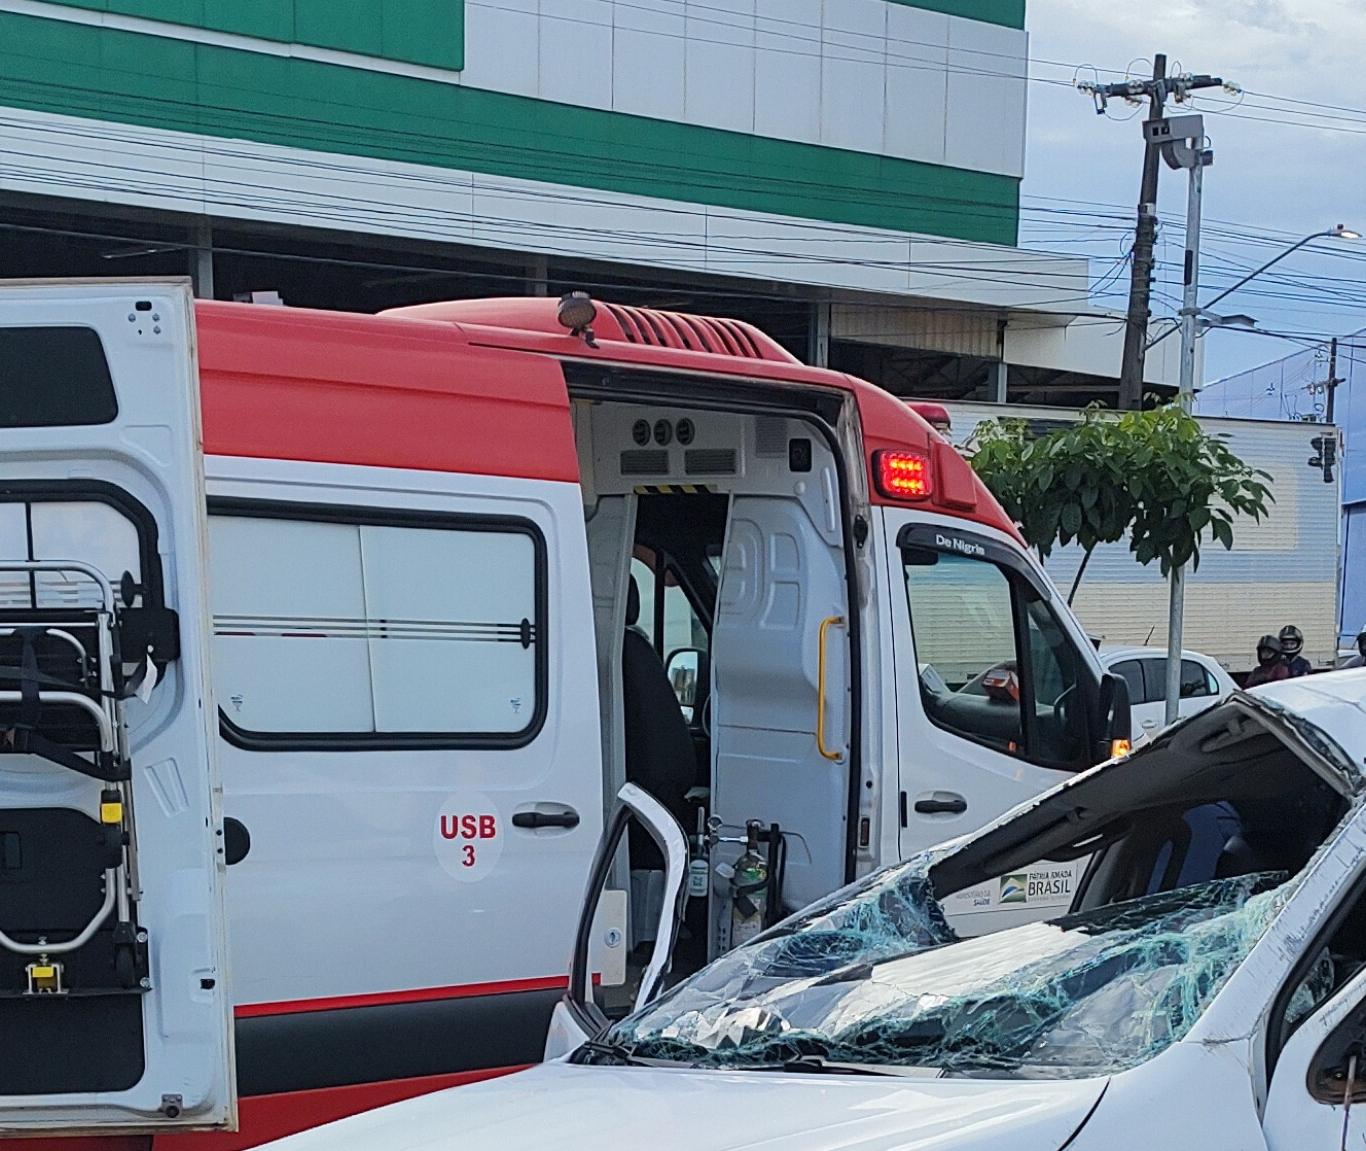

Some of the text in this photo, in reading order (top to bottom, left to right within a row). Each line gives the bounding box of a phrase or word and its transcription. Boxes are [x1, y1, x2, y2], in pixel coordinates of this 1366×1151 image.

[936, 534, 985, 555] De Nigris
[440, 814, 496, 840] USB
[462, 844, 476, 867] 3
[1028, 879, 1071, 896] BRASIL
